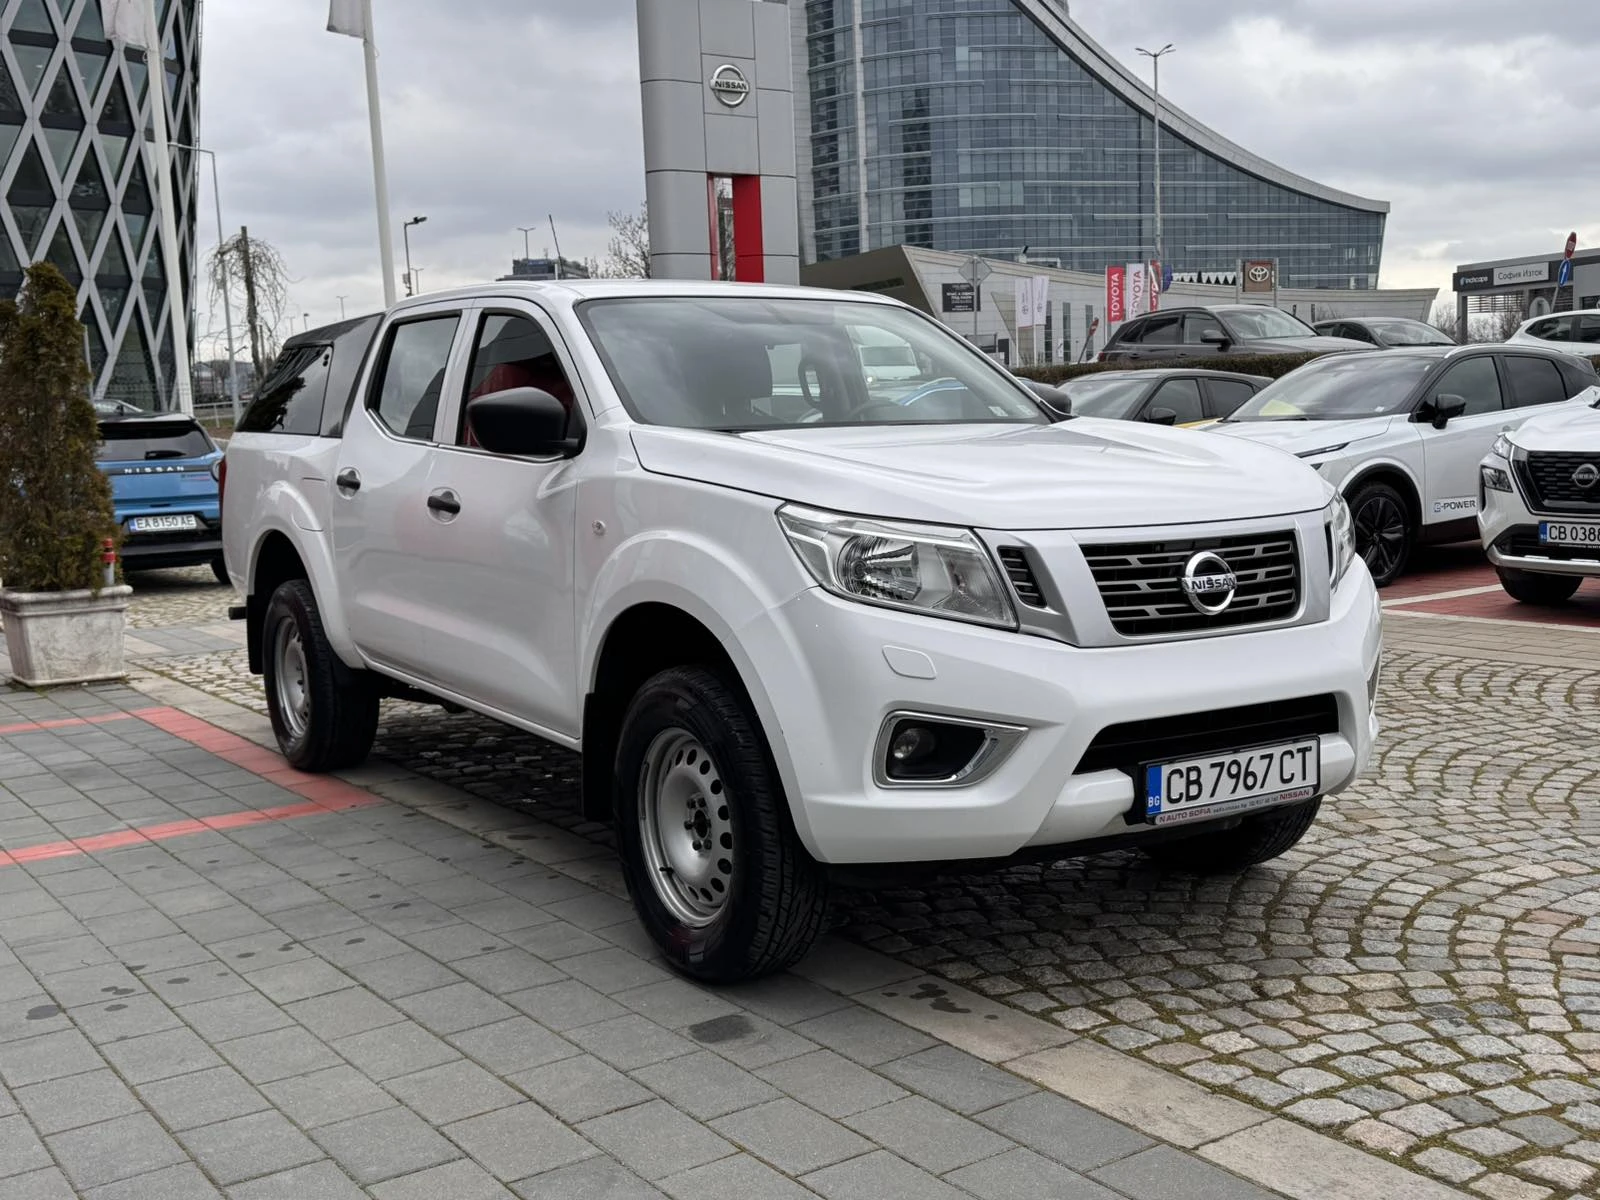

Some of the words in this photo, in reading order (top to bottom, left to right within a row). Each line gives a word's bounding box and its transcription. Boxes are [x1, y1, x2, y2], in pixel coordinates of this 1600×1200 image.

[714, 80, 747, 90] NISSAN
[1498, 270, 1521, 281] София
[1523, 268, 1543, 278] Изток
[1111, 272, 1120, 318] TOYOTA
[124, 466, 184, 474] NISSAN
[136, 517, 152, 529] EA
[153, 515, 178, 528] 8150
[181, 515, 194, 526] AE
[1549, 525, 1567, 541] CB
[1191, 577, 1236, 590] NISSAN
[1166, 765, 1203, 804] CB
[1209, 752, 1274, 798] 7967
[1279, 745, 1313, 784] CT
[1280, 789, 1310, 800] NISSAN
[1148, 795, 1160, 808] BG
[1166, 811, 1188, 821] AUTO
[1189, 807, 1211, 817] SOFIA
